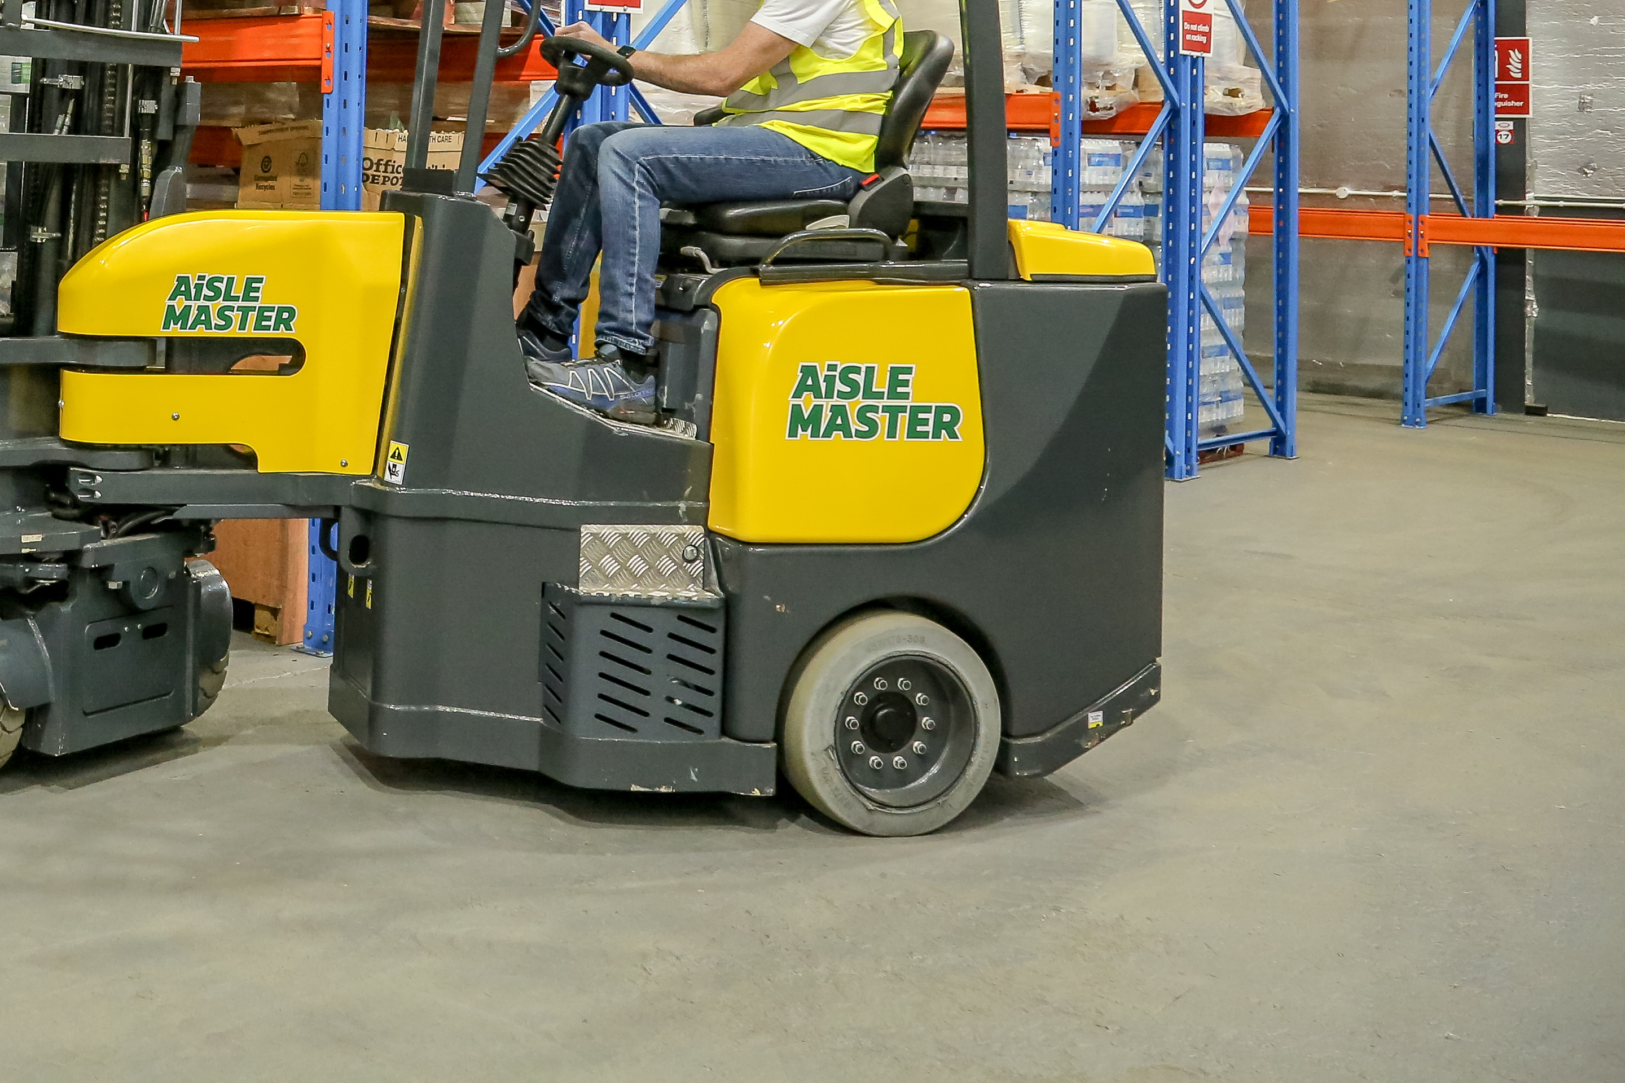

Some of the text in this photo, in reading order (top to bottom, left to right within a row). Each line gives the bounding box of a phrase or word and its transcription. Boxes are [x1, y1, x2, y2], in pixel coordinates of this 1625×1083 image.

[1184, 22, 1190, 30] Do
[1198, 24, 1210, 32] climb
[363, 157, 404, 174] Offic
[161, 302, 297, 332] MASTER
[786, 402, 962, 441] MASTER
